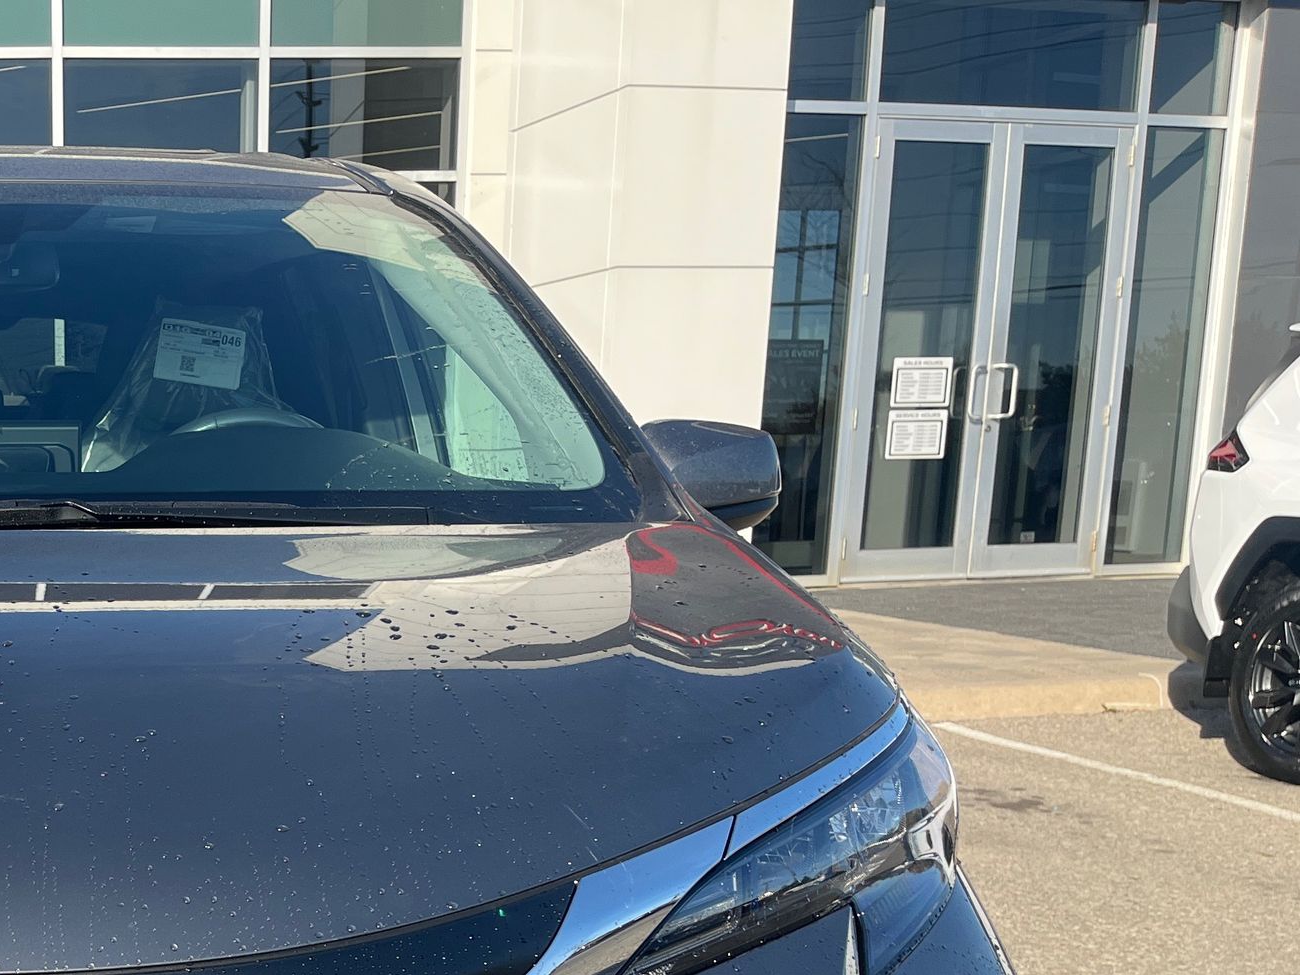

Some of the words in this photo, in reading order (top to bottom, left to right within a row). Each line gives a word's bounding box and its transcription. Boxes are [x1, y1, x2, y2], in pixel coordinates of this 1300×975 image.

[221, 335, 242, 347] 046
[767, 349, 790, 358] ALES
[790, 349, 820, 358] EVENT
